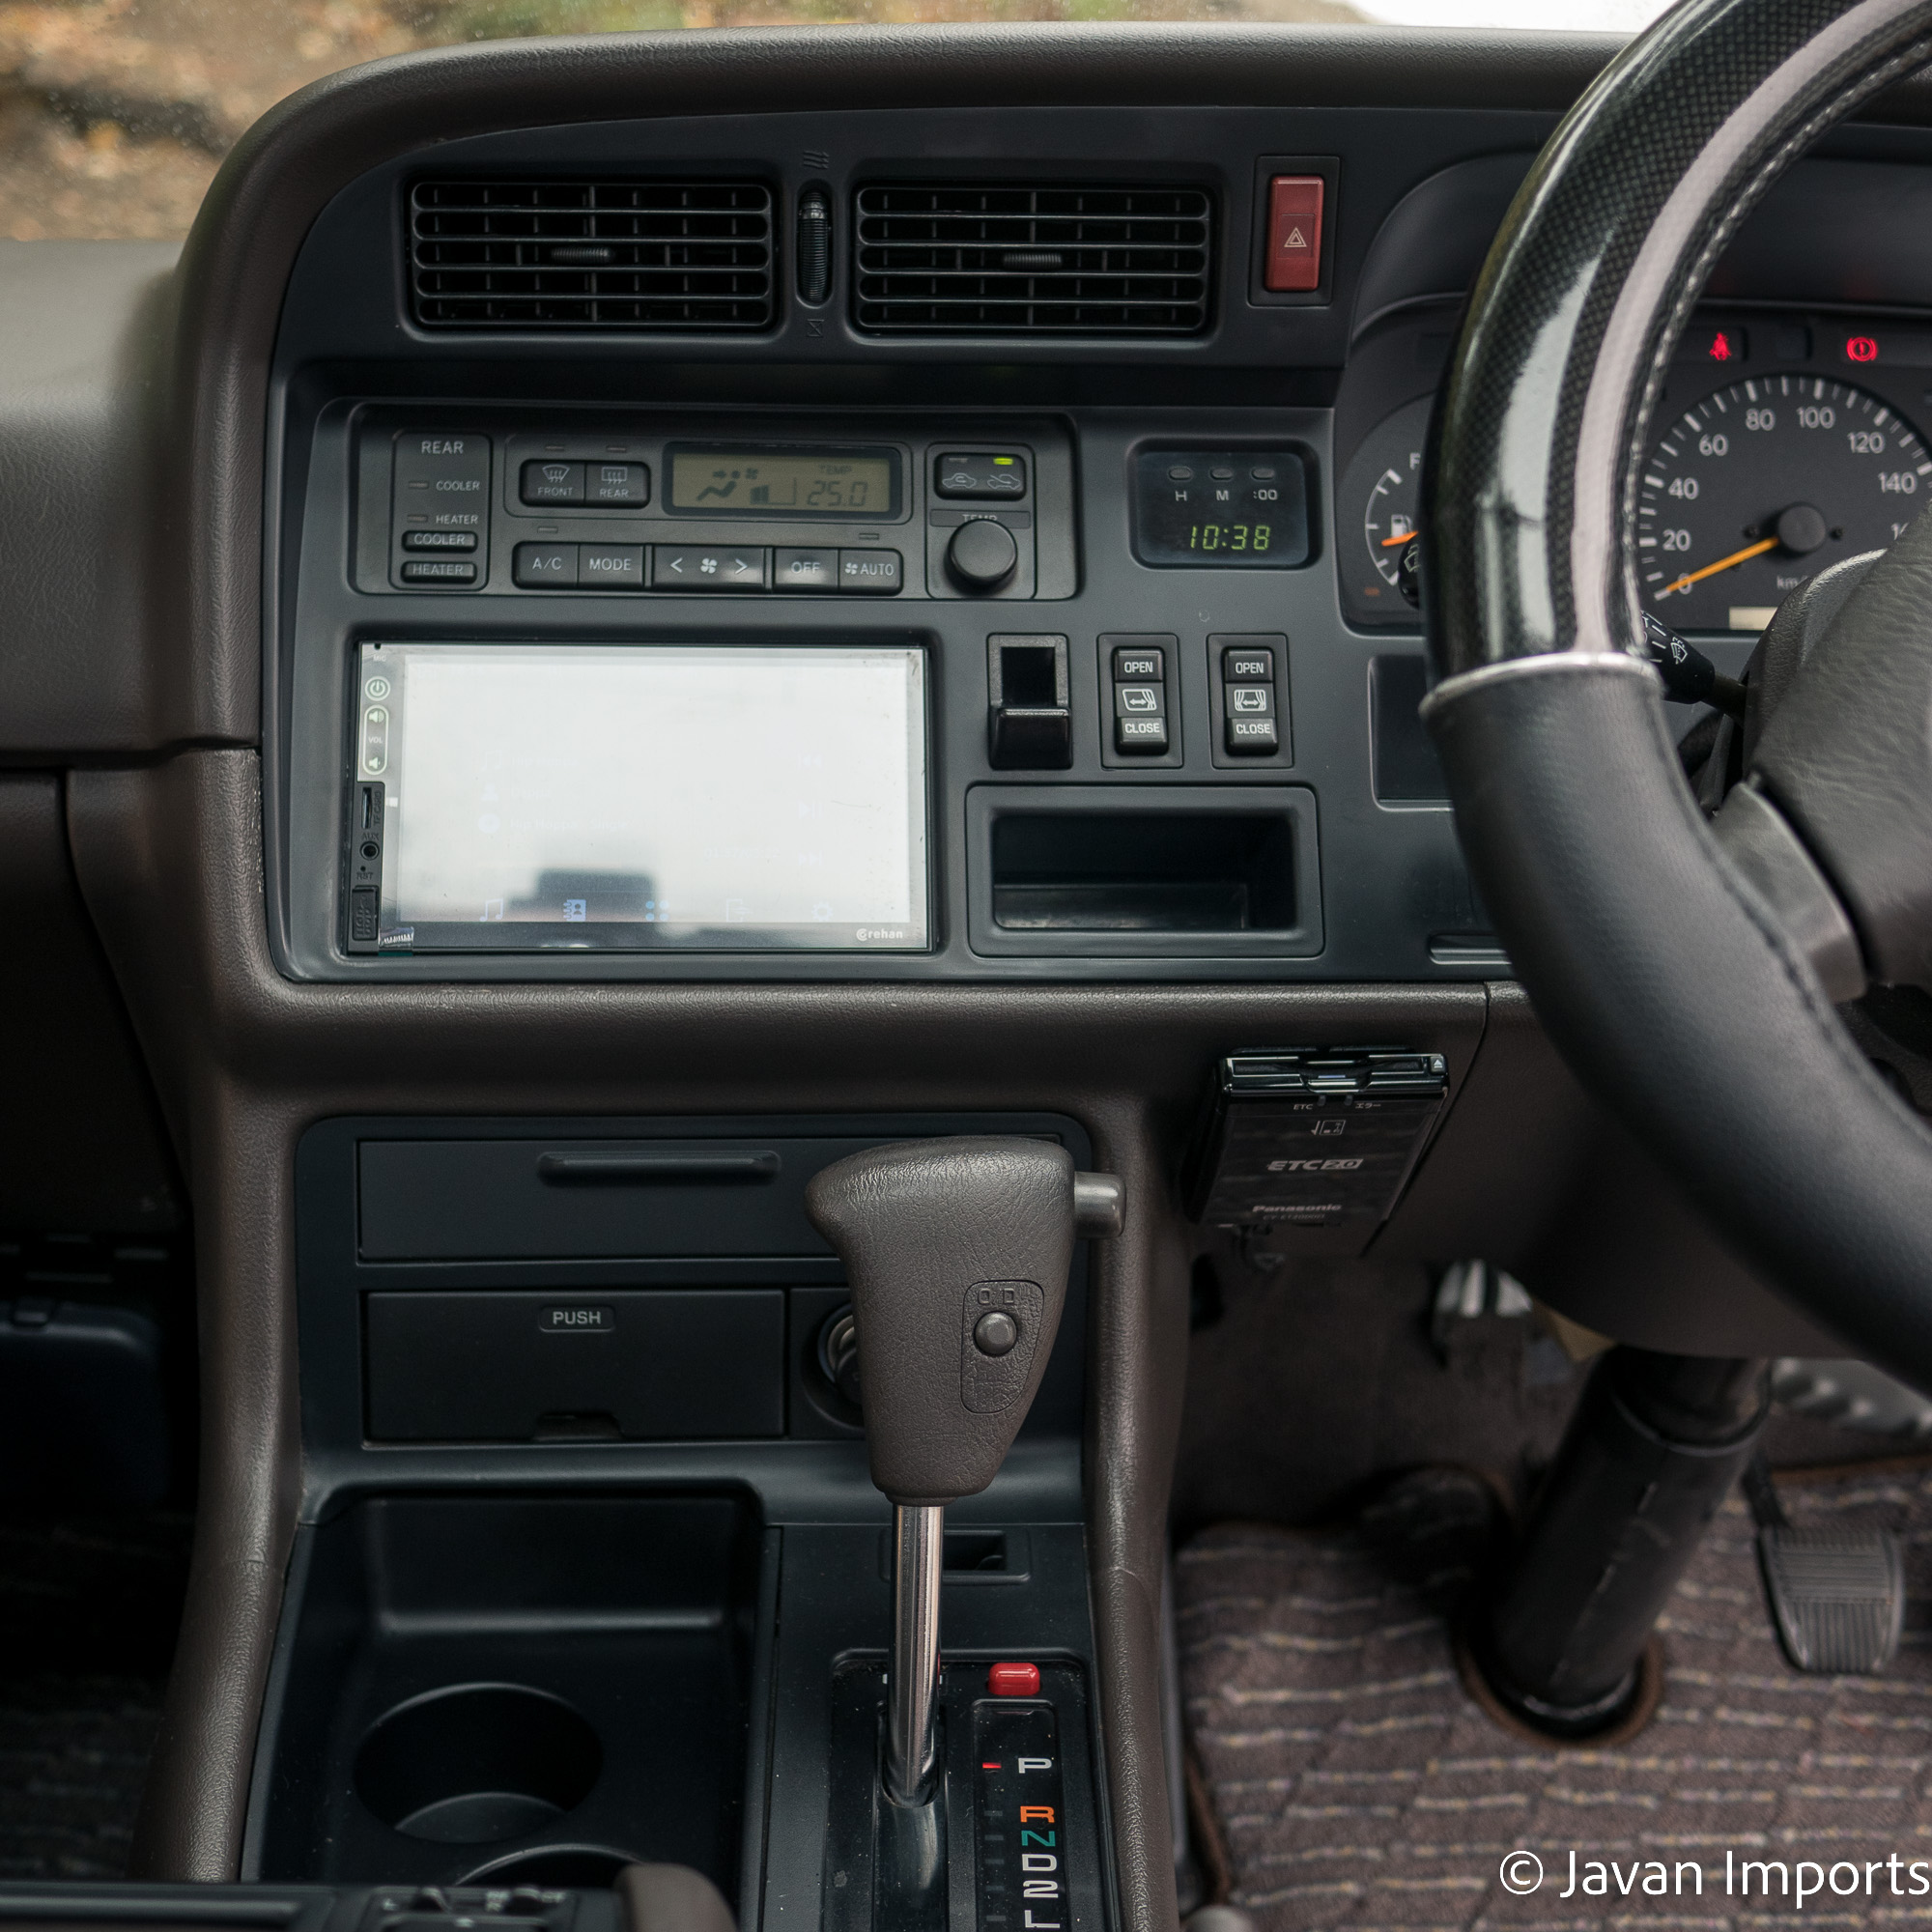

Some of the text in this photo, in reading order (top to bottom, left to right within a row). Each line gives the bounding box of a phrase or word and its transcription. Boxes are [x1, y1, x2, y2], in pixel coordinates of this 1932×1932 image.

[1746, 409, 1776, 431] 80
[1796, 407, 1834, 429] 100
[421, 440, 464, 454] REAR
[1698, 434, 1729, 456] 60
[1847, 432, 1885, 454] 120
[1409, 452, 1421, 470] F
[819, 464, 852, 475] TEMP
[436, 480, 480, 492] COOLER
[1668, 477, 1699, 499] 40
[1878, 471, 1918, 495] 140
[537, 487, 573, 497] FRONT
[599, 488, 629, 498] REAR
[807, 479, 868, 507] 25.0
[1175, 491, 1187, 501] H
[1216, 490, 1229, 501] M
[436, 514, 479, 525] HEATER
[413, 533, 466, 546] COOLER
[1190, 526, 1271, 550] 10:38
[1662, 529, 1691, 552] 20
[412, 563, 464, 576] HEATER
[532, 556, 562, 571] A/C
[589, 558, 632, 571] MODE
[791, 561, 820, 574] OFF
[860, 562, 895, 576] AUTO
[1123, 662, 1153, 673] OPEN
[1235, 662, 1264, 674] OPEN
[1124, 723, 1160, 734] CLOSE
[1236, 724, 1271, 734] CLOSE
[362, 832, 380, 842] AUX
[1252, 1204, 1343, 1213] Panasonic
[553, 1311, 601, 1324] PUSH
[1018, 1757, 1053, 1774] P
[1020, 1805, 1055, 1823] R
[1021, 1831, 1056, 1847] N
[1022, 1854, 1058, 1871] D
[1023, 1880, 1059, 1898] 2
[1024, 1910, 1061, 1928] L
